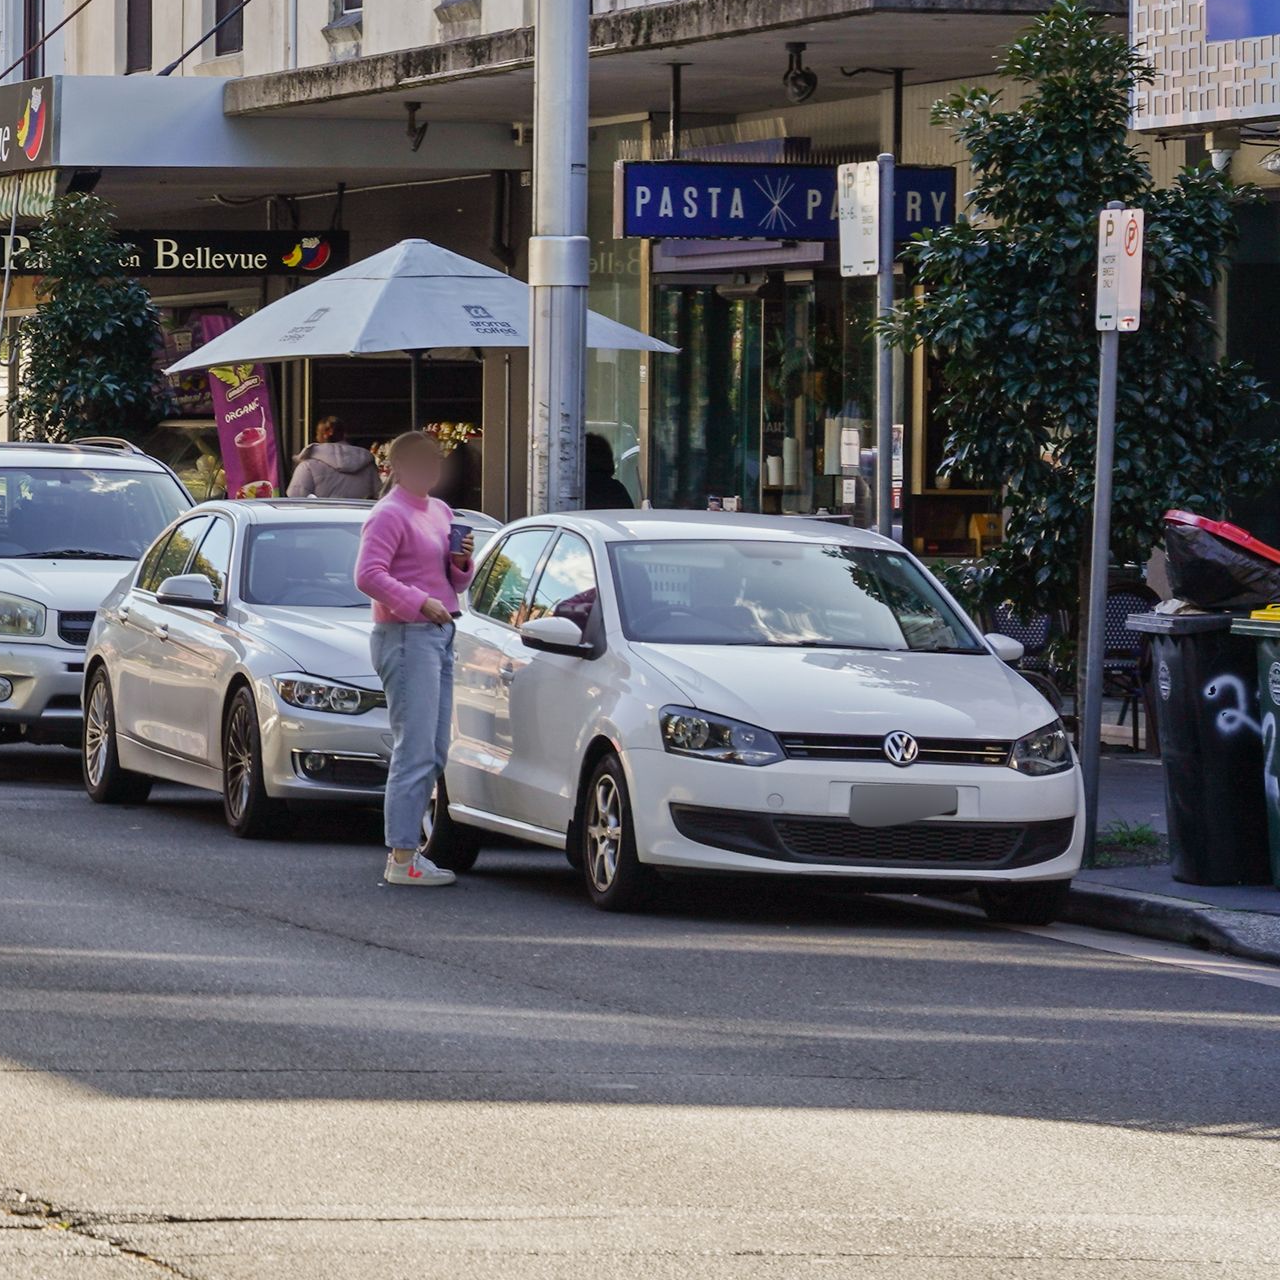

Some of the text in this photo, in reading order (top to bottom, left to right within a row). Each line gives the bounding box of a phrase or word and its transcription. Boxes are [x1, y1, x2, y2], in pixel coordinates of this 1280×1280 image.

[635, 185, 947, 223] PASTA PARY
[1105, 219, 1115, 247] P
[153, 238, 267, 270] Bellevue
